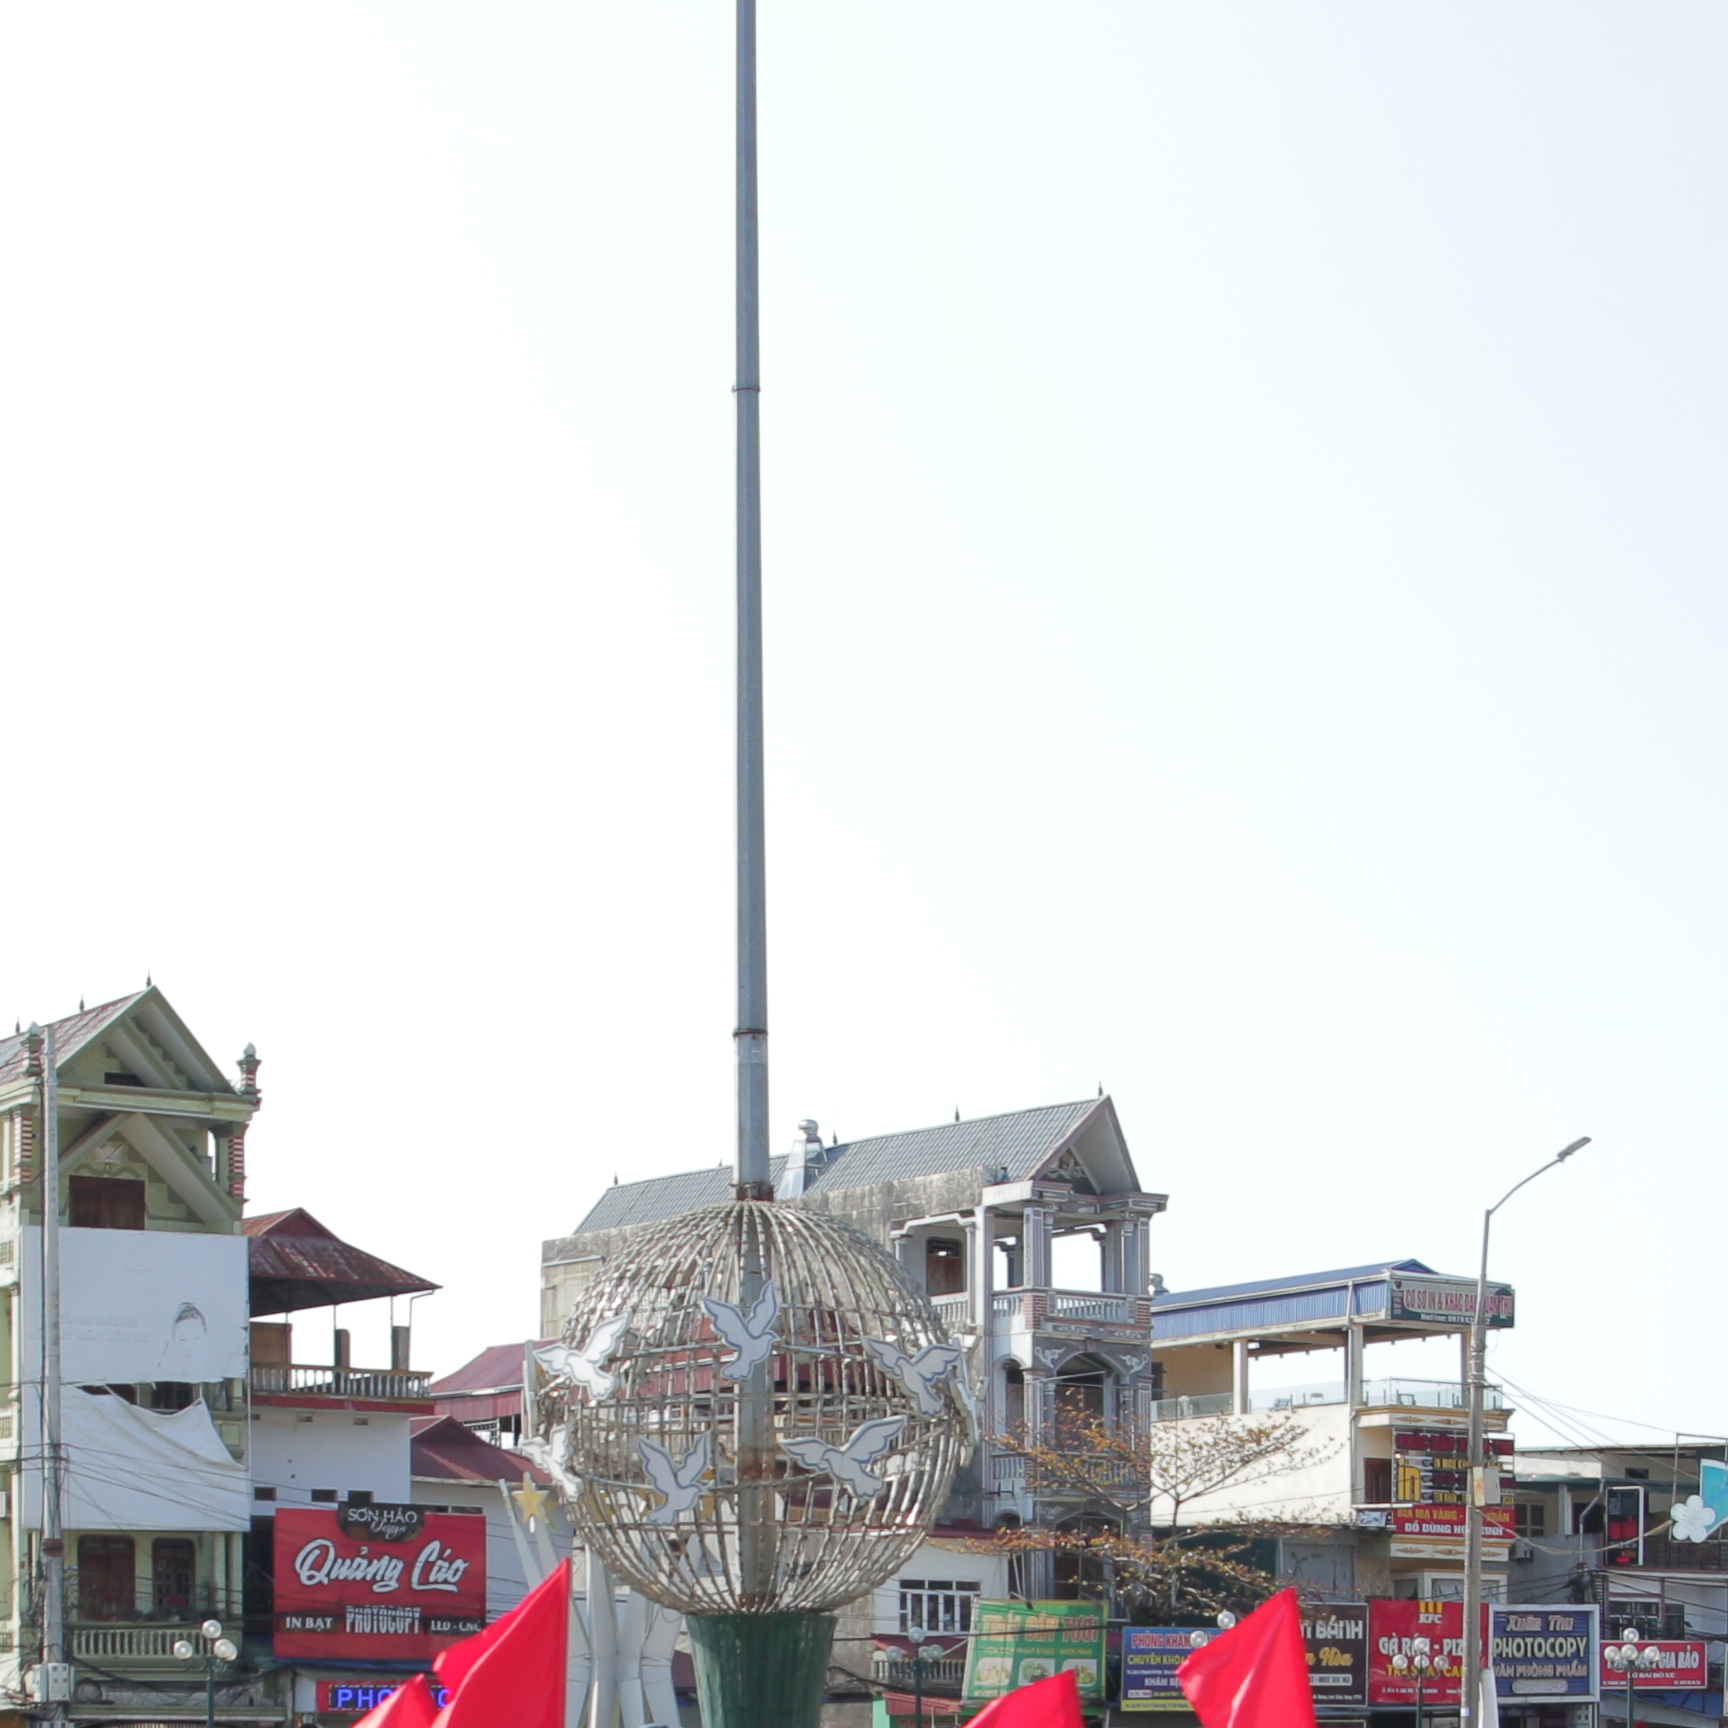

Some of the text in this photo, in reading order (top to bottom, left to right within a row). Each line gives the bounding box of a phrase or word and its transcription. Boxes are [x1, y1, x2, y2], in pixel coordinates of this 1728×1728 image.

[348, 1507, 417, 1524] SƠN HẢO
[295, 1538, 470, 1593] Quảng Cáo
[285, 1616, 303, 1629] IN
[305, 1617, 334, 1632] BẠT
[346, 1605, 421, 1634] PHOTOCOPY
[1378, 1632, 1399, 1655] GÀ
[1493, 1636, 1587, 1658] PHOTOCOPY
[1677, 1644, 1700, 1669] BẢO
